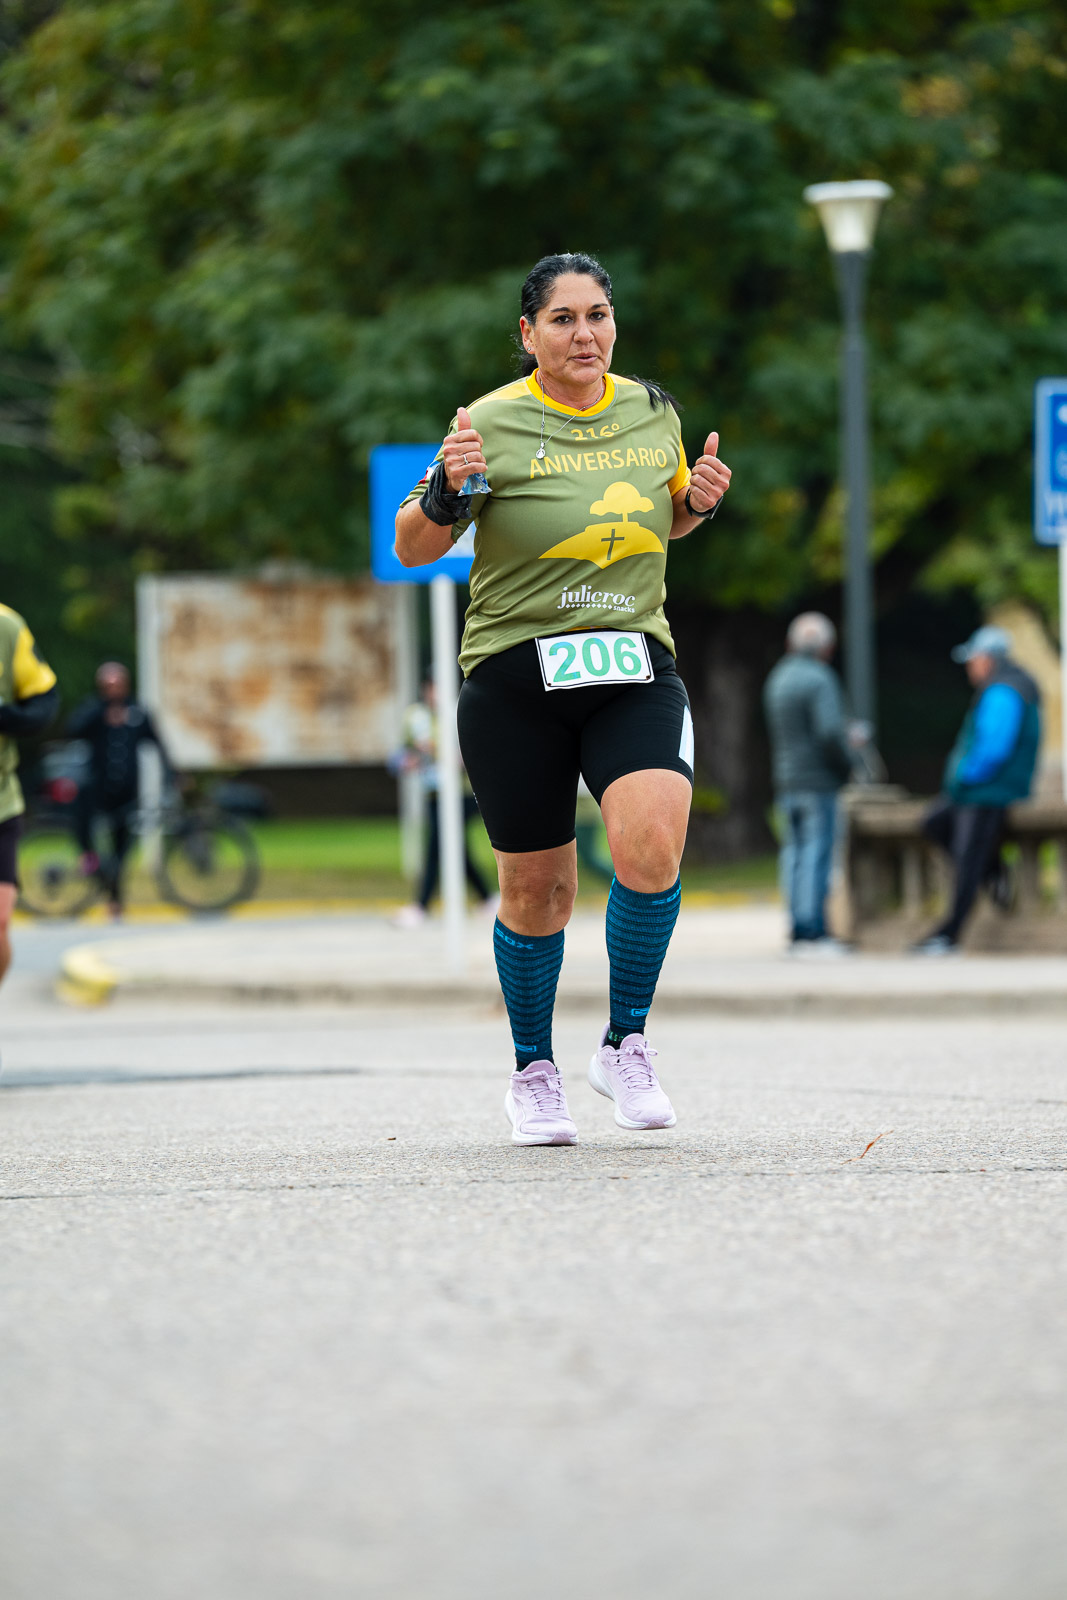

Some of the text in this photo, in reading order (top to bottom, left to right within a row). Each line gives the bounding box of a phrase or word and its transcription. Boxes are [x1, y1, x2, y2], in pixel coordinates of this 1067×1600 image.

[529, 447, 668, 479] ANIVERSARIO
[557, 584, 635, 609] julicroc
[613, 605, 636, 614] snacks
[548, 636, 642, 683] 206
